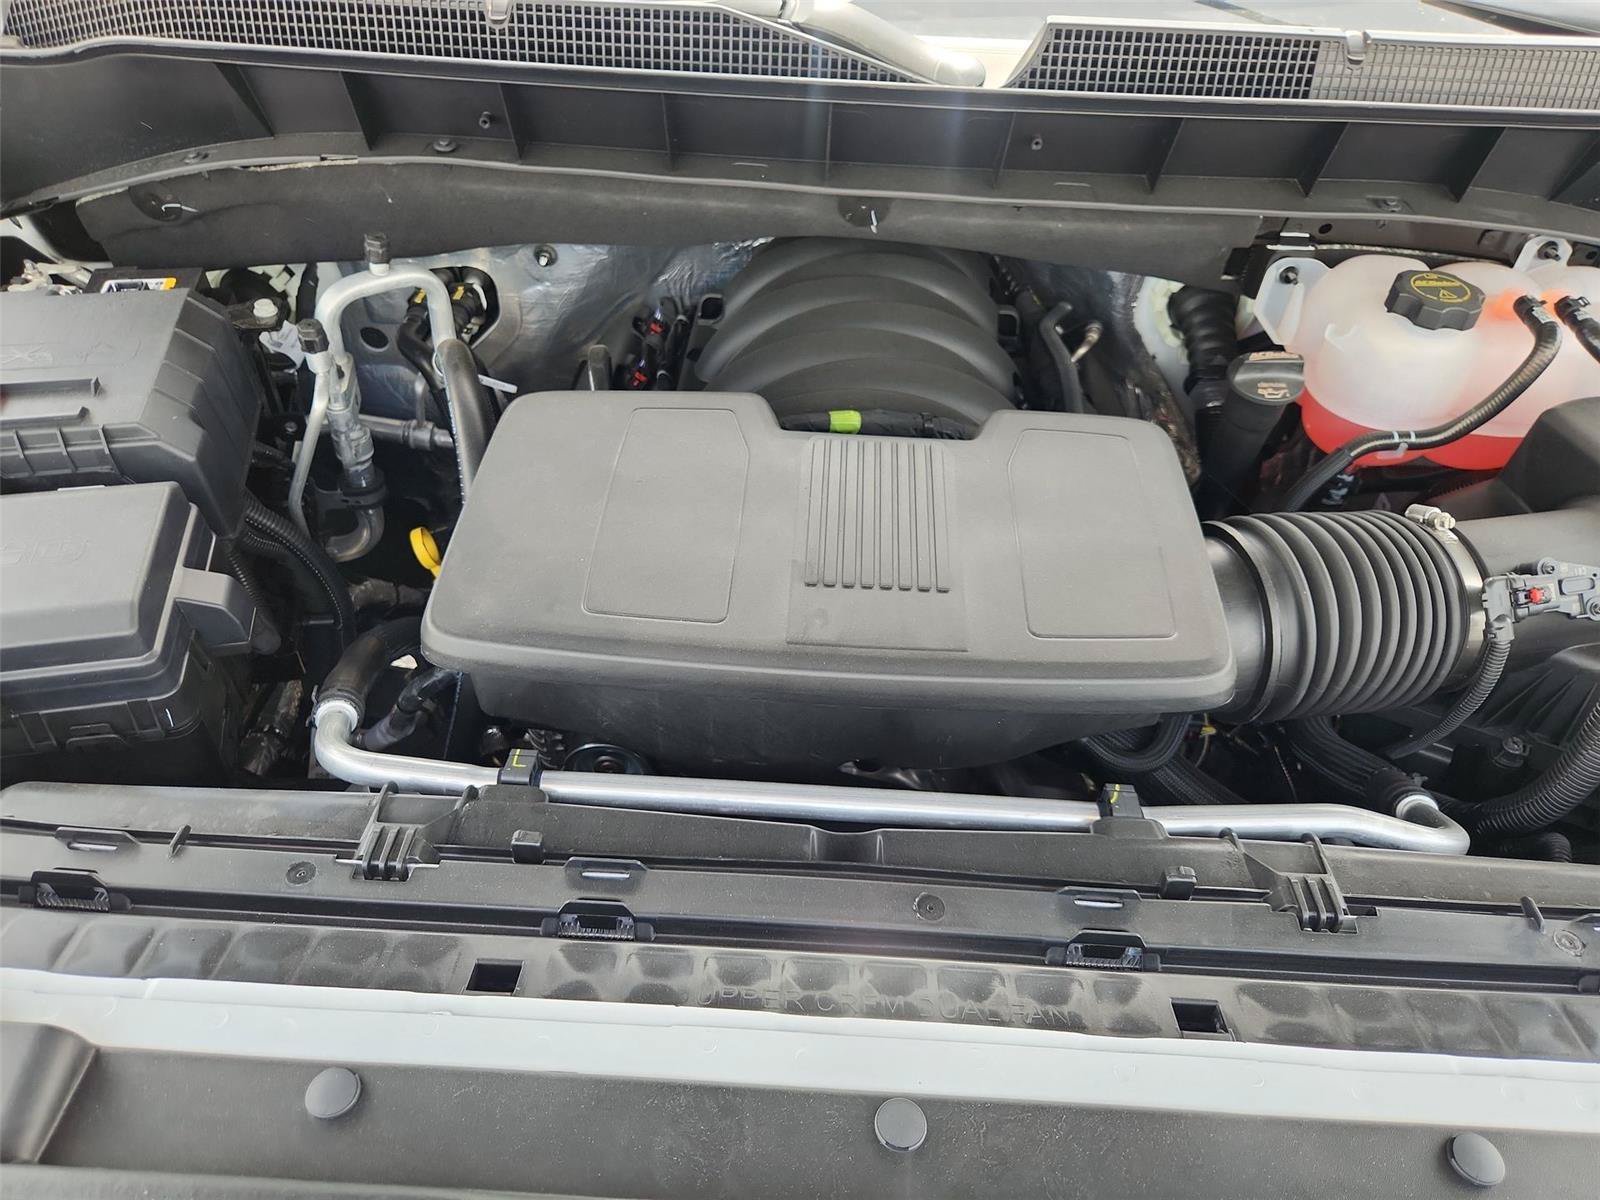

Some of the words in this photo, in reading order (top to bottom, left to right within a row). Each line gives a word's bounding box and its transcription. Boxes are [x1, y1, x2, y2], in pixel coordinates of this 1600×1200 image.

[698, 986, 808, 1015] UPPER
[918, 995, 1001, 1021] DUAL
[1010, 1002, 1071, 1025] FAN
